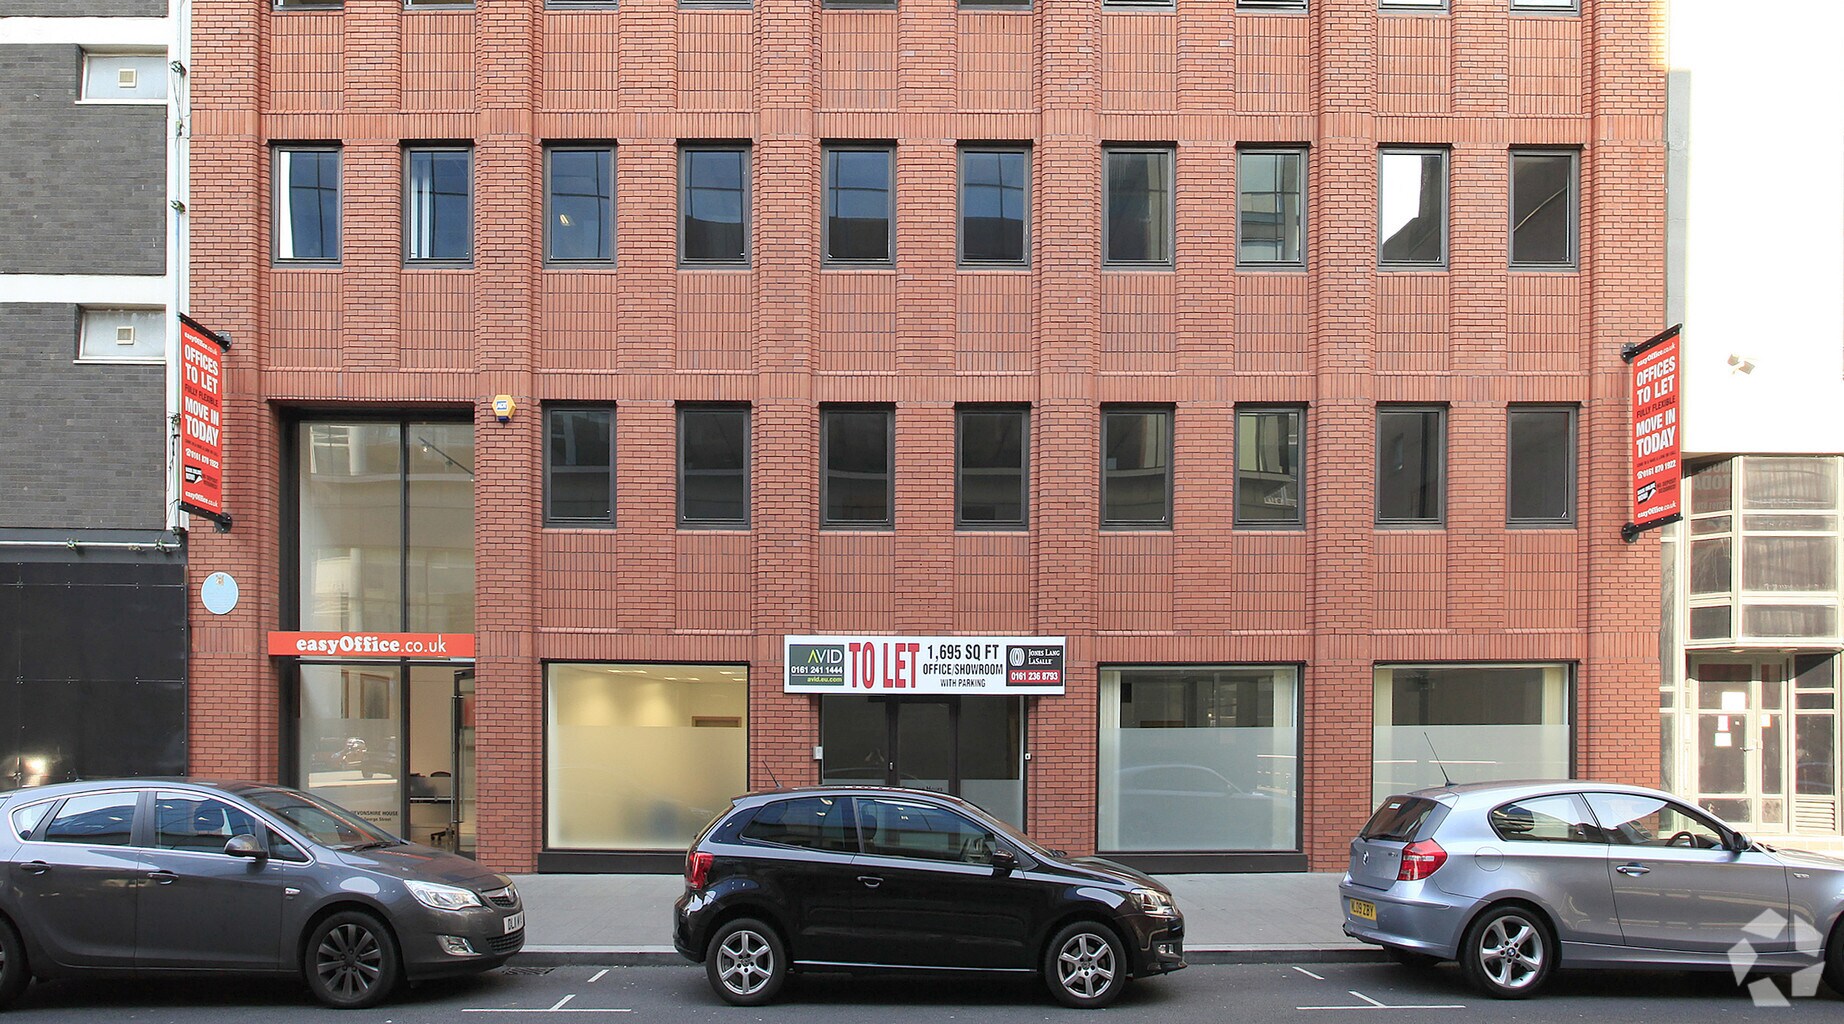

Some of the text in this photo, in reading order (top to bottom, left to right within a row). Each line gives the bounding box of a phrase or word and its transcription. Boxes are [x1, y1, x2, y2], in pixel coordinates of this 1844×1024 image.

[184, 344, 219, 376] OFFICES
[1636, 342, 1676, 367] easyOffice.co.uk
[184, 362, 218, 394] TO LET
[1636, 355, 1676, 387] OFFICES
[184, 384, 198, 397] FULLY
[1636, 374, 1675, 406] TO LET
[185, 396, 220, 426] MOVE IN
[1636, 395, 1676, 418] FULLY FLEXIBLE
[184, 414, 219, 447] TODAY
[1636, 407, 1676, 437] MOVE IN
[1636, 425, 1676, 458] TODAY
[296, 634, 447, 655] easyOffice.co.uk
[807, 649, 843, 664] AVID
[928, 644, 999, 662] 1,695 SQ FT
[791, 666, 843, 674] 0161 241 1444
[849, 641, 920, 689] TO LET
[923, 663, 1003, 675] OFFICE/SHOWROOM
[1011, 672, 1058, 680] 0161 236 8793
[940, 679, 986, 687] WITH PARKING
